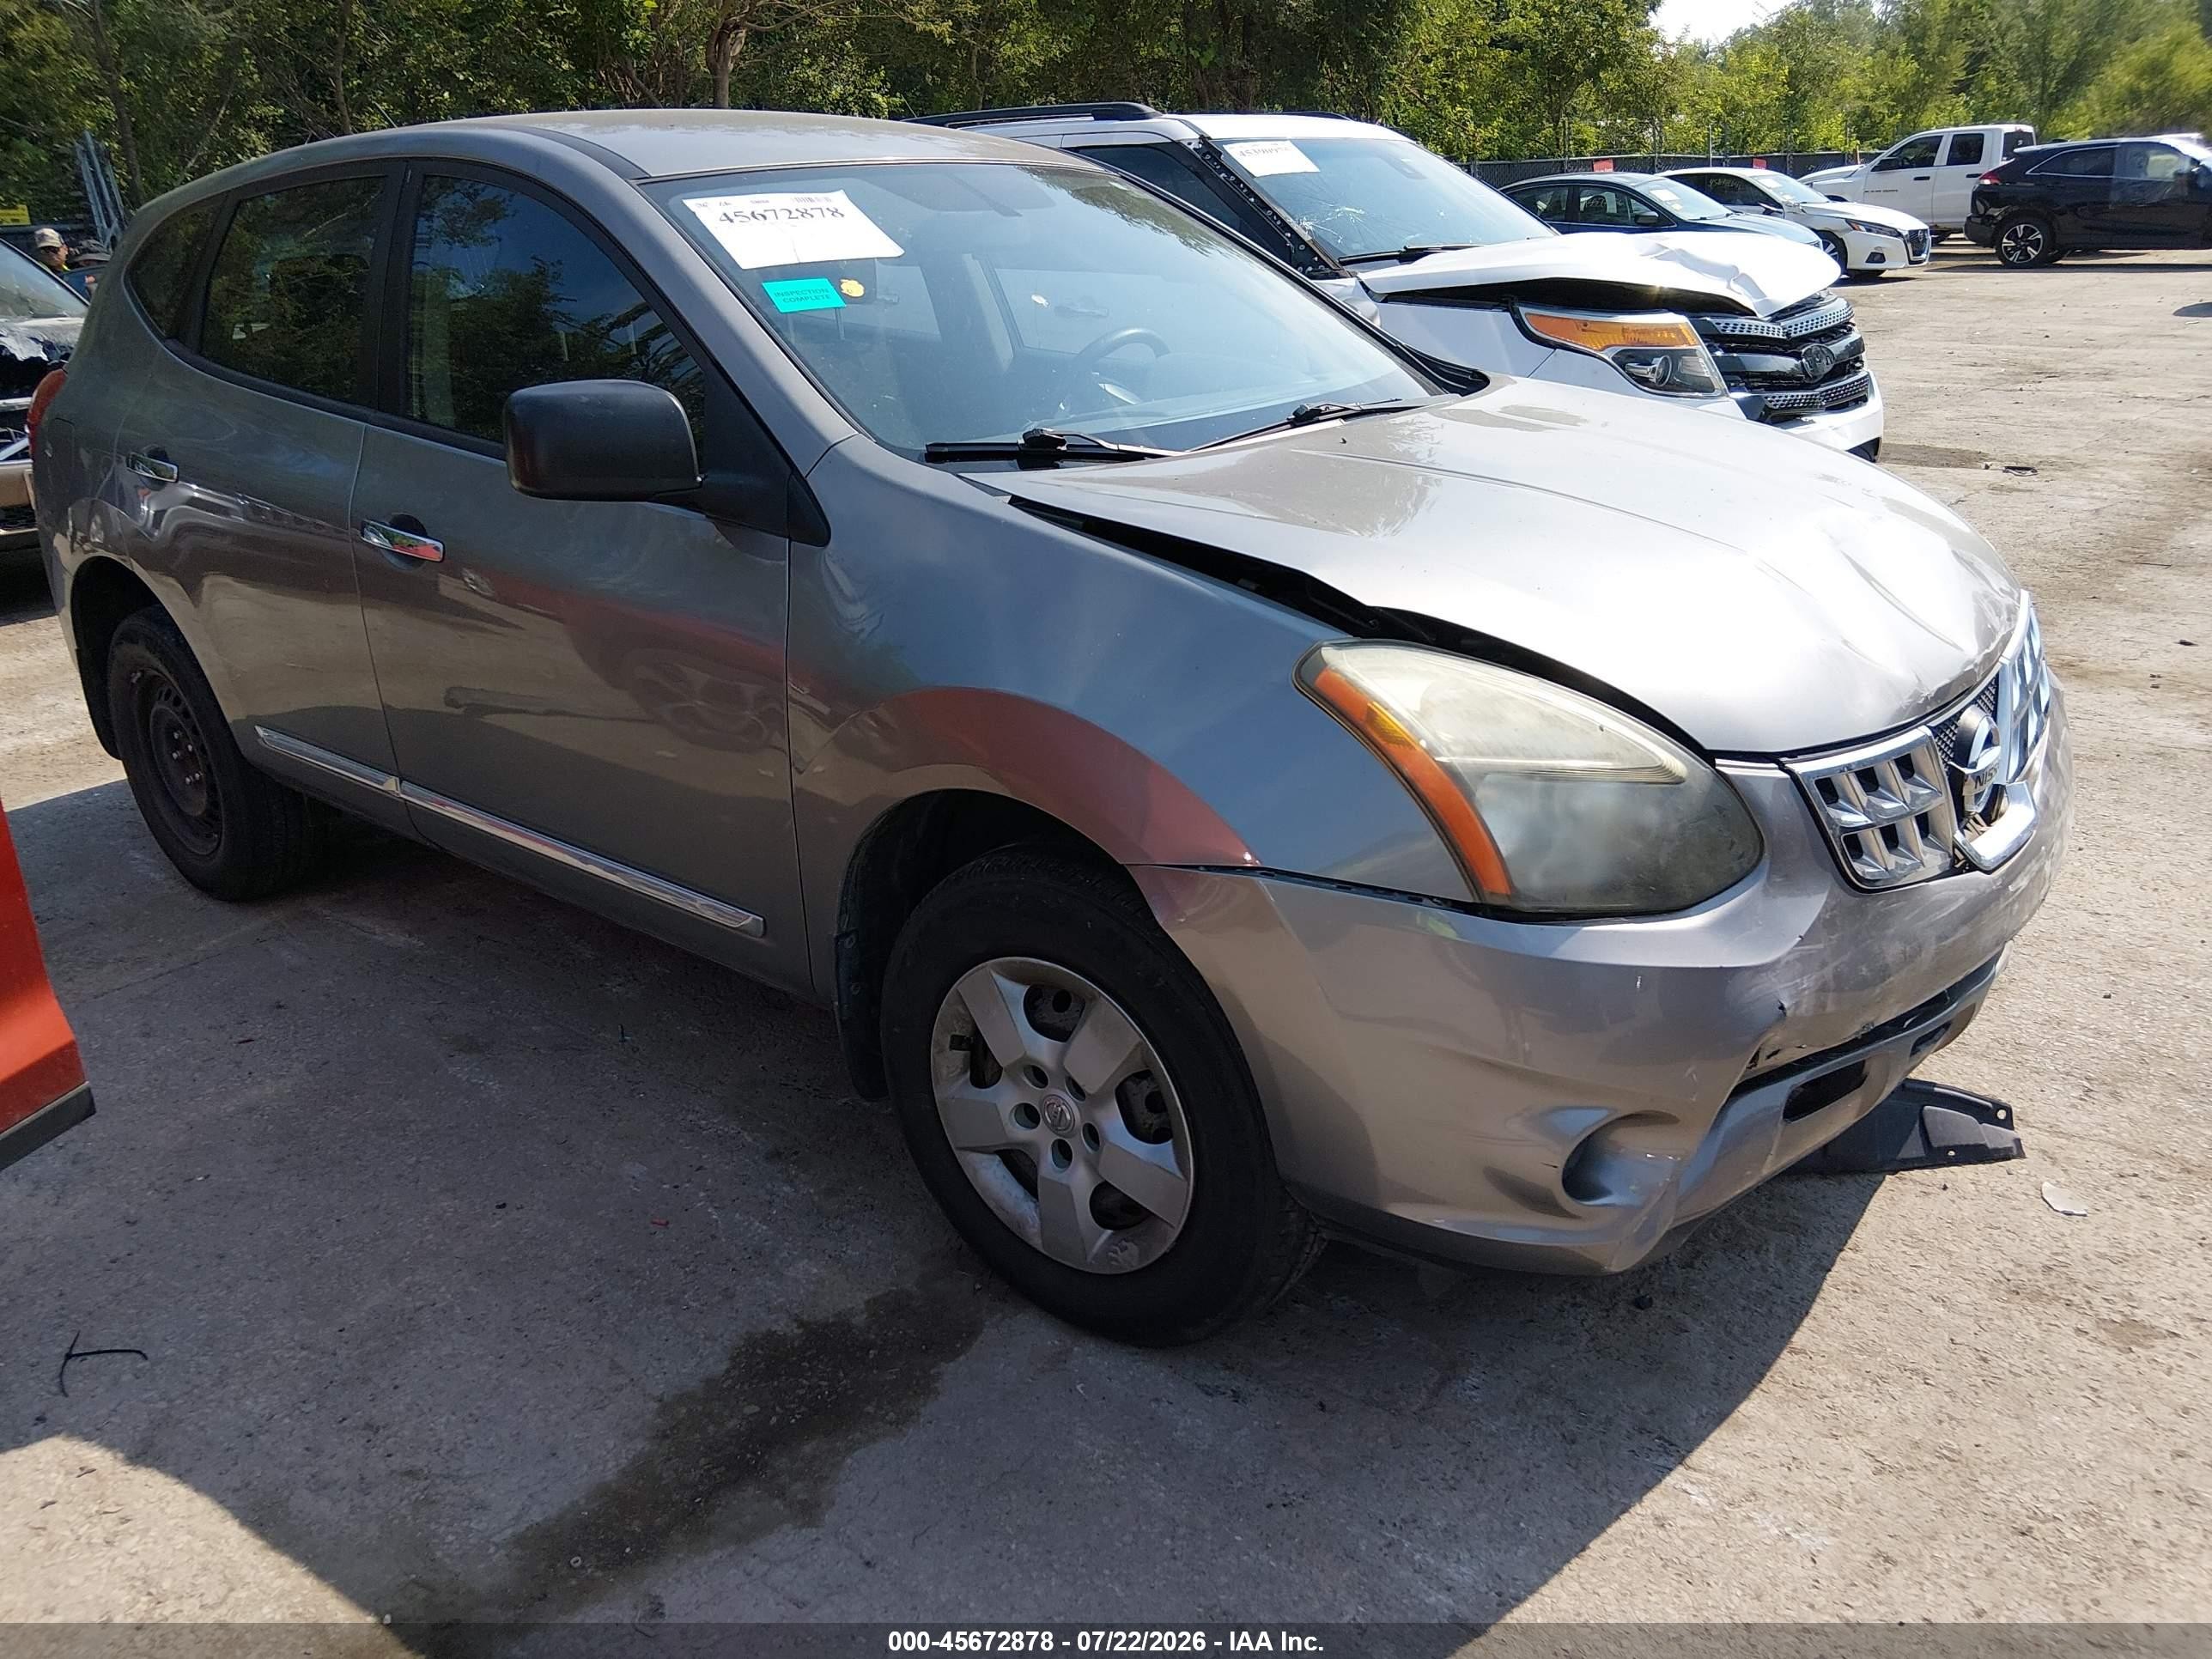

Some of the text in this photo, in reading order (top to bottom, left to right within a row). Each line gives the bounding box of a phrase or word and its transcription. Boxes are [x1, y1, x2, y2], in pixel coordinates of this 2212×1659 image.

[719, 207, 845, 223] 45672878
[775, 289, 830, 297] INSPECTION
[782, 295, 830, 303] COMPLETE
